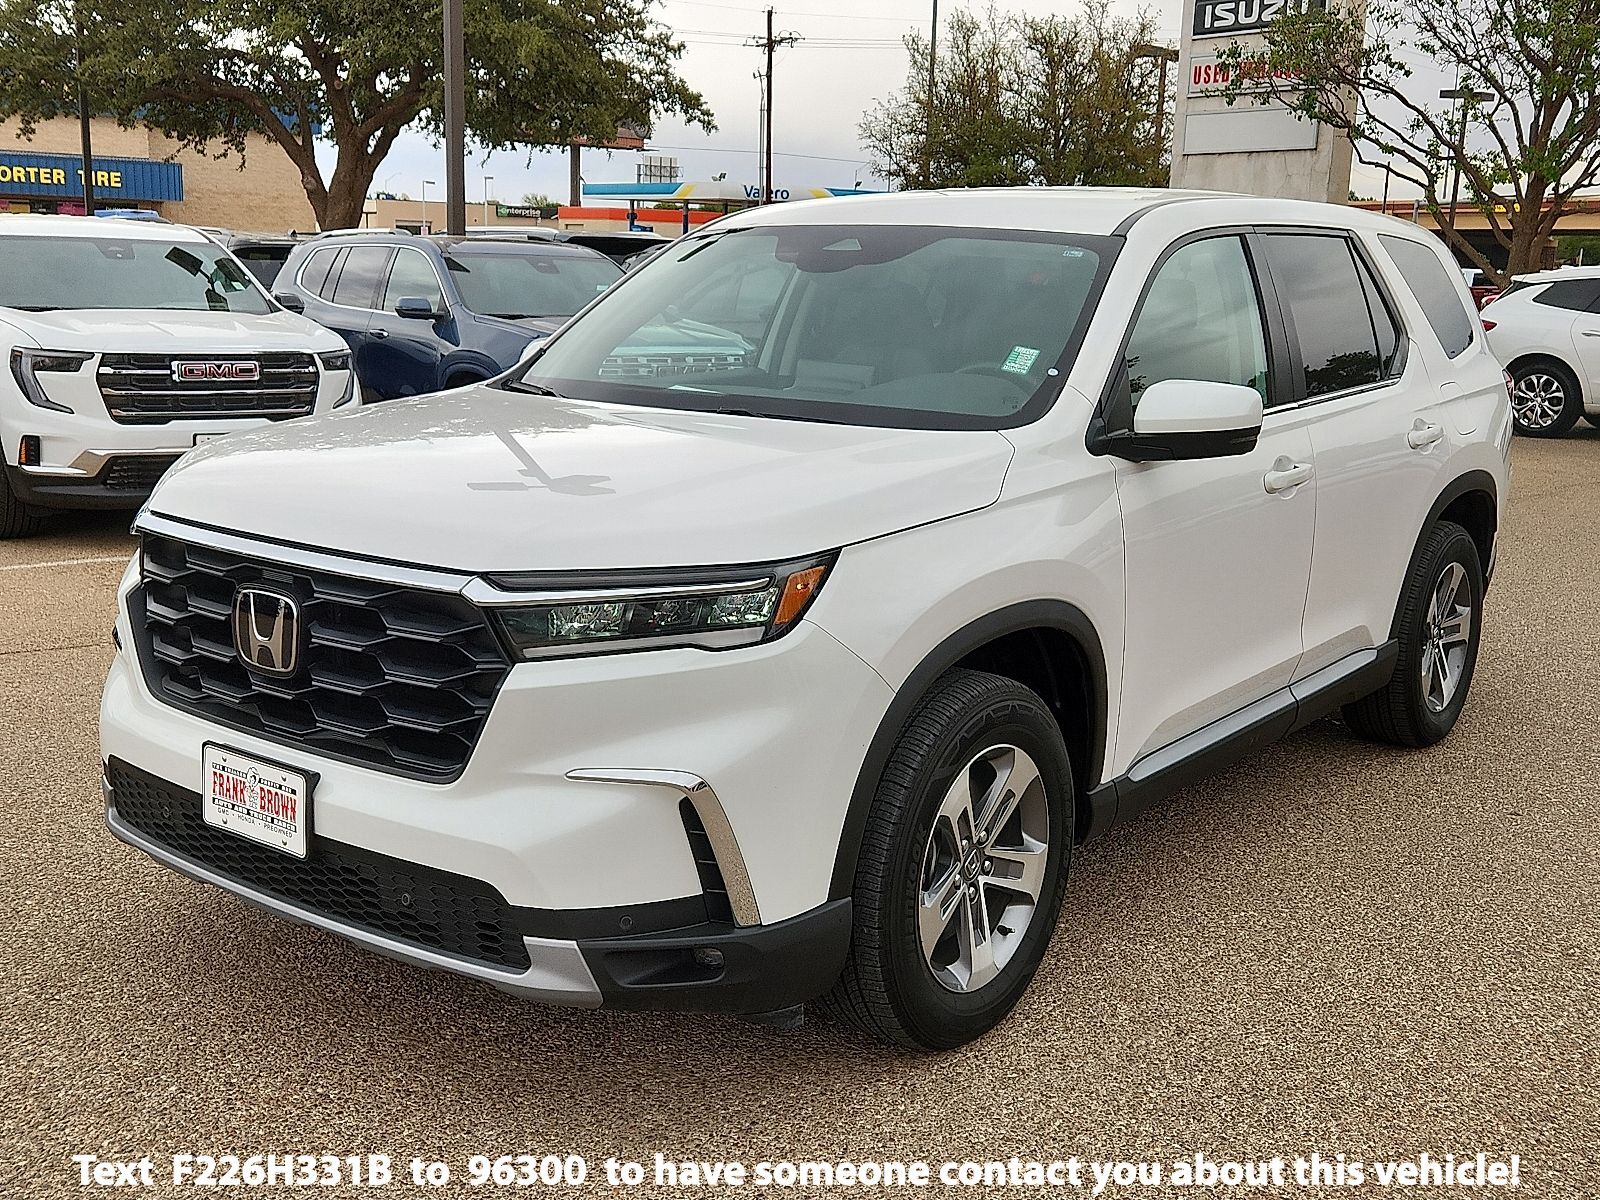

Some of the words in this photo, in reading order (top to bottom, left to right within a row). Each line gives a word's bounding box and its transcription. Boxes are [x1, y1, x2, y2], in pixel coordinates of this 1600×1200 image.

[0, 165, 66, 185] ORTER
[181, 362, 258, 380] GMC
[212, 770, 246, 806] FRANK
[259, 786, 296, 823] BROWN
[214, 797, 232, 809] AUTO
[233, 804, 247, 815] AND
[249, 810, 271, 823] TRUCK
[273, 818, 297, 833] RANCH
[237, 813, 255, 825] HONDA
